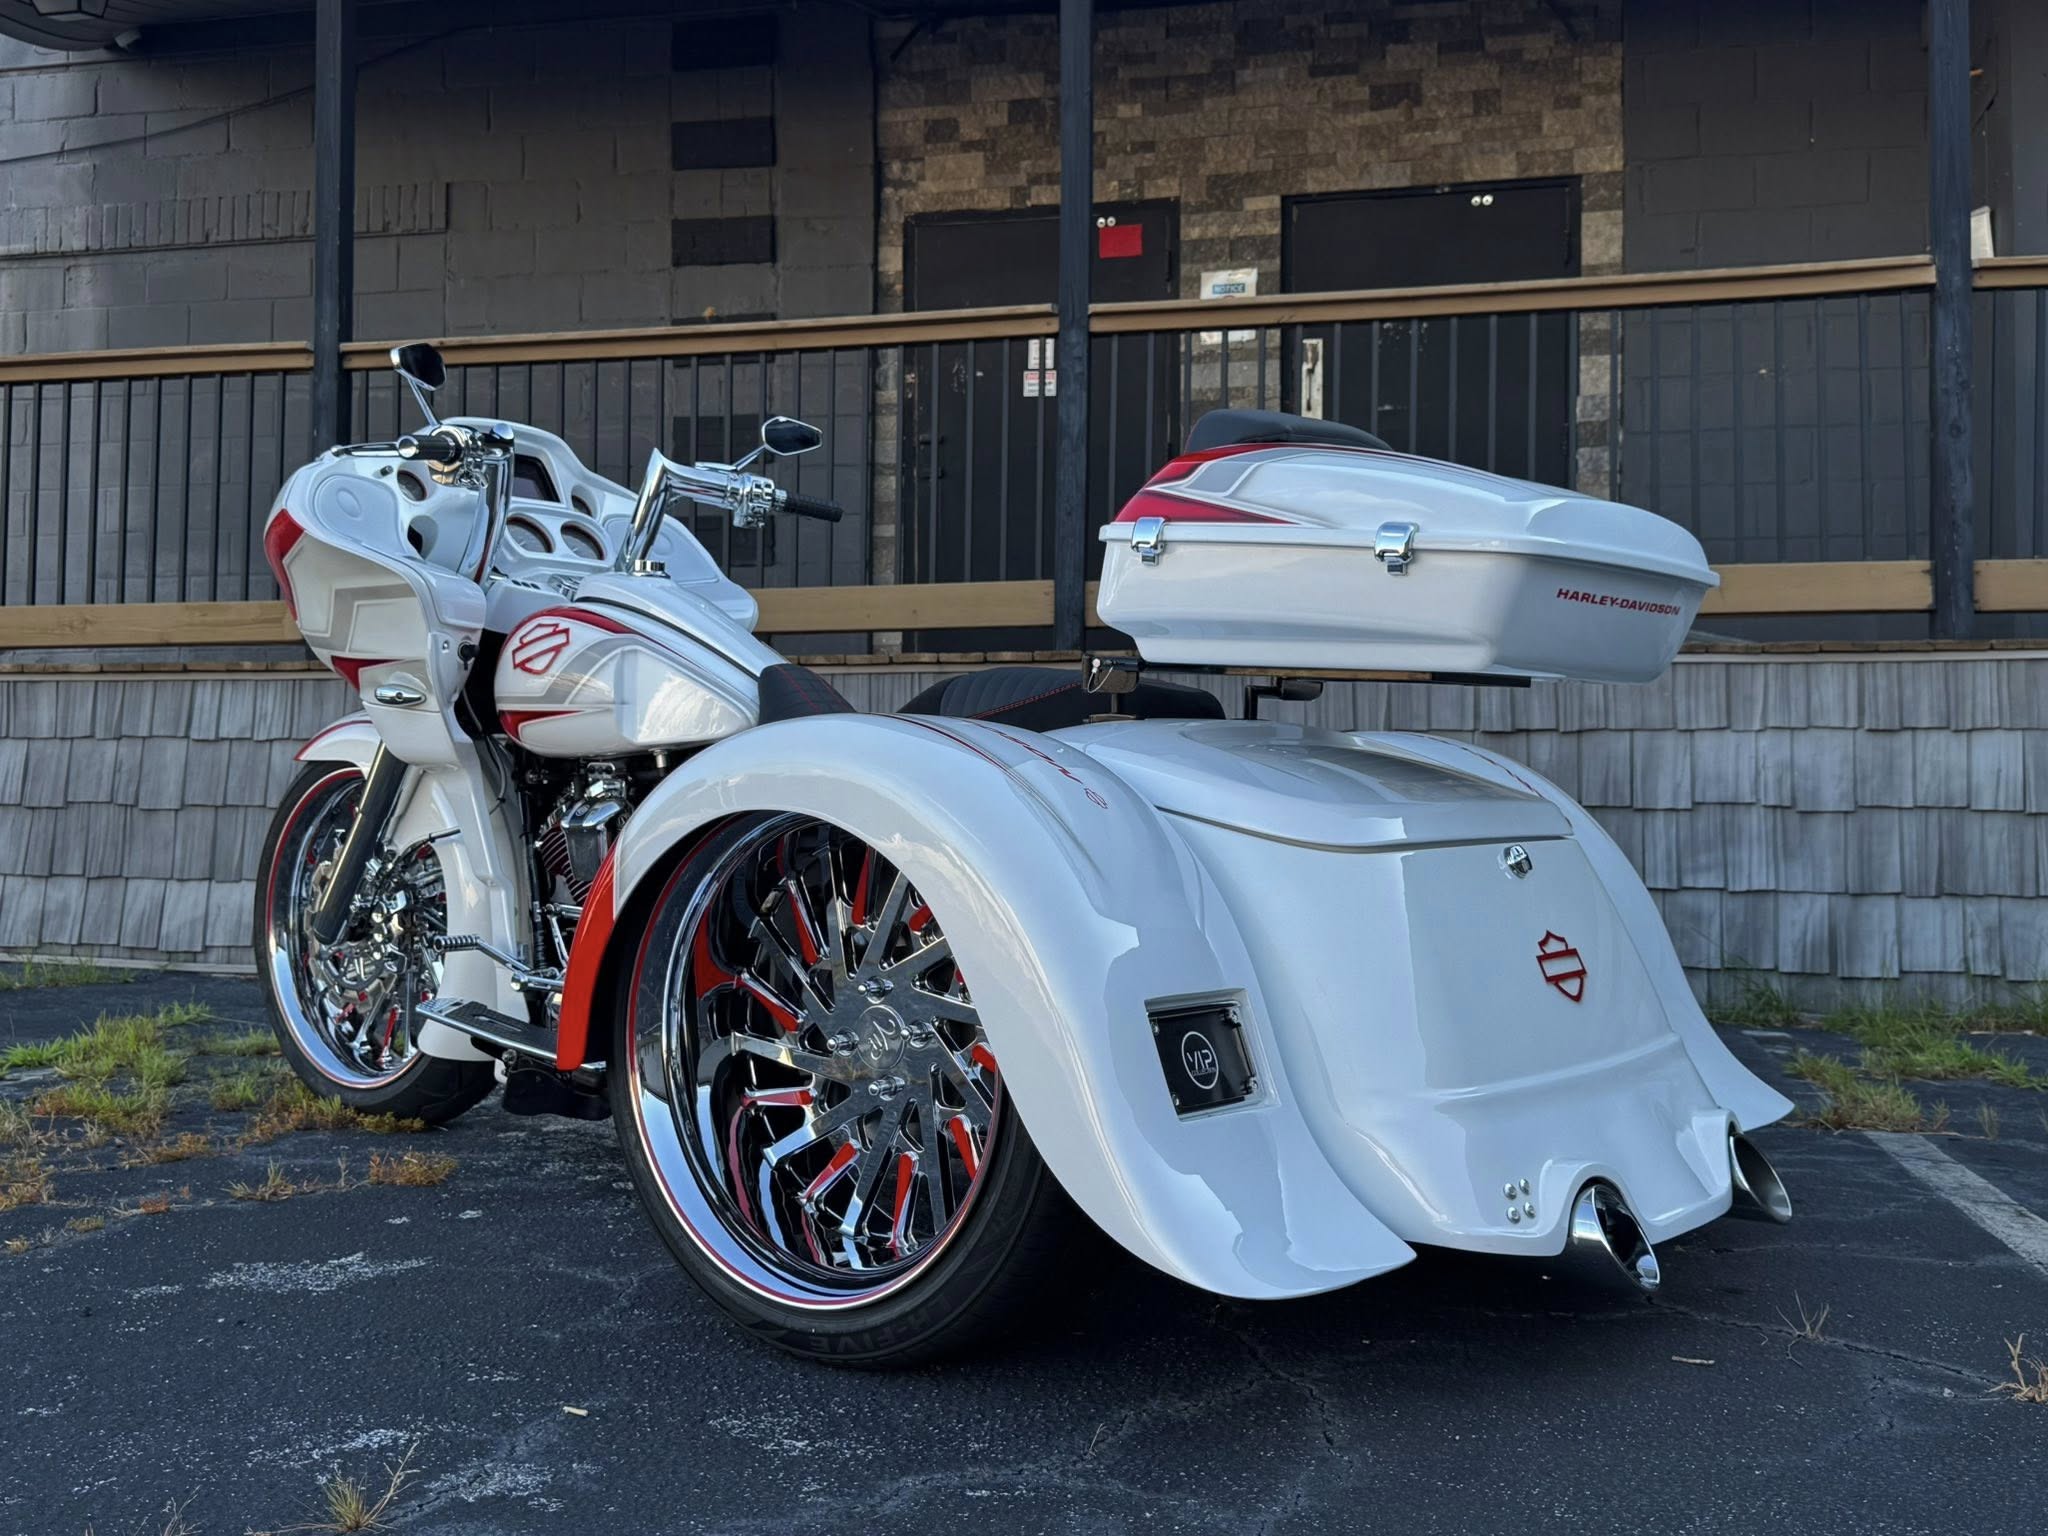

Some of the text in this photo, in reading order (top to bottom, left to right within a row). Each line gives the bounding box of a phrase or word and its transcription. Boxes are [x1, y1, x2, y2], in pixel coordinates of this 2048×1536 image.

[1213, 284, 1244, 293] NOTICE
[1556, 588, 1681, 615] HARLEY-DAVIDSON
[1186, 1049, 1212, 1070] VIP
